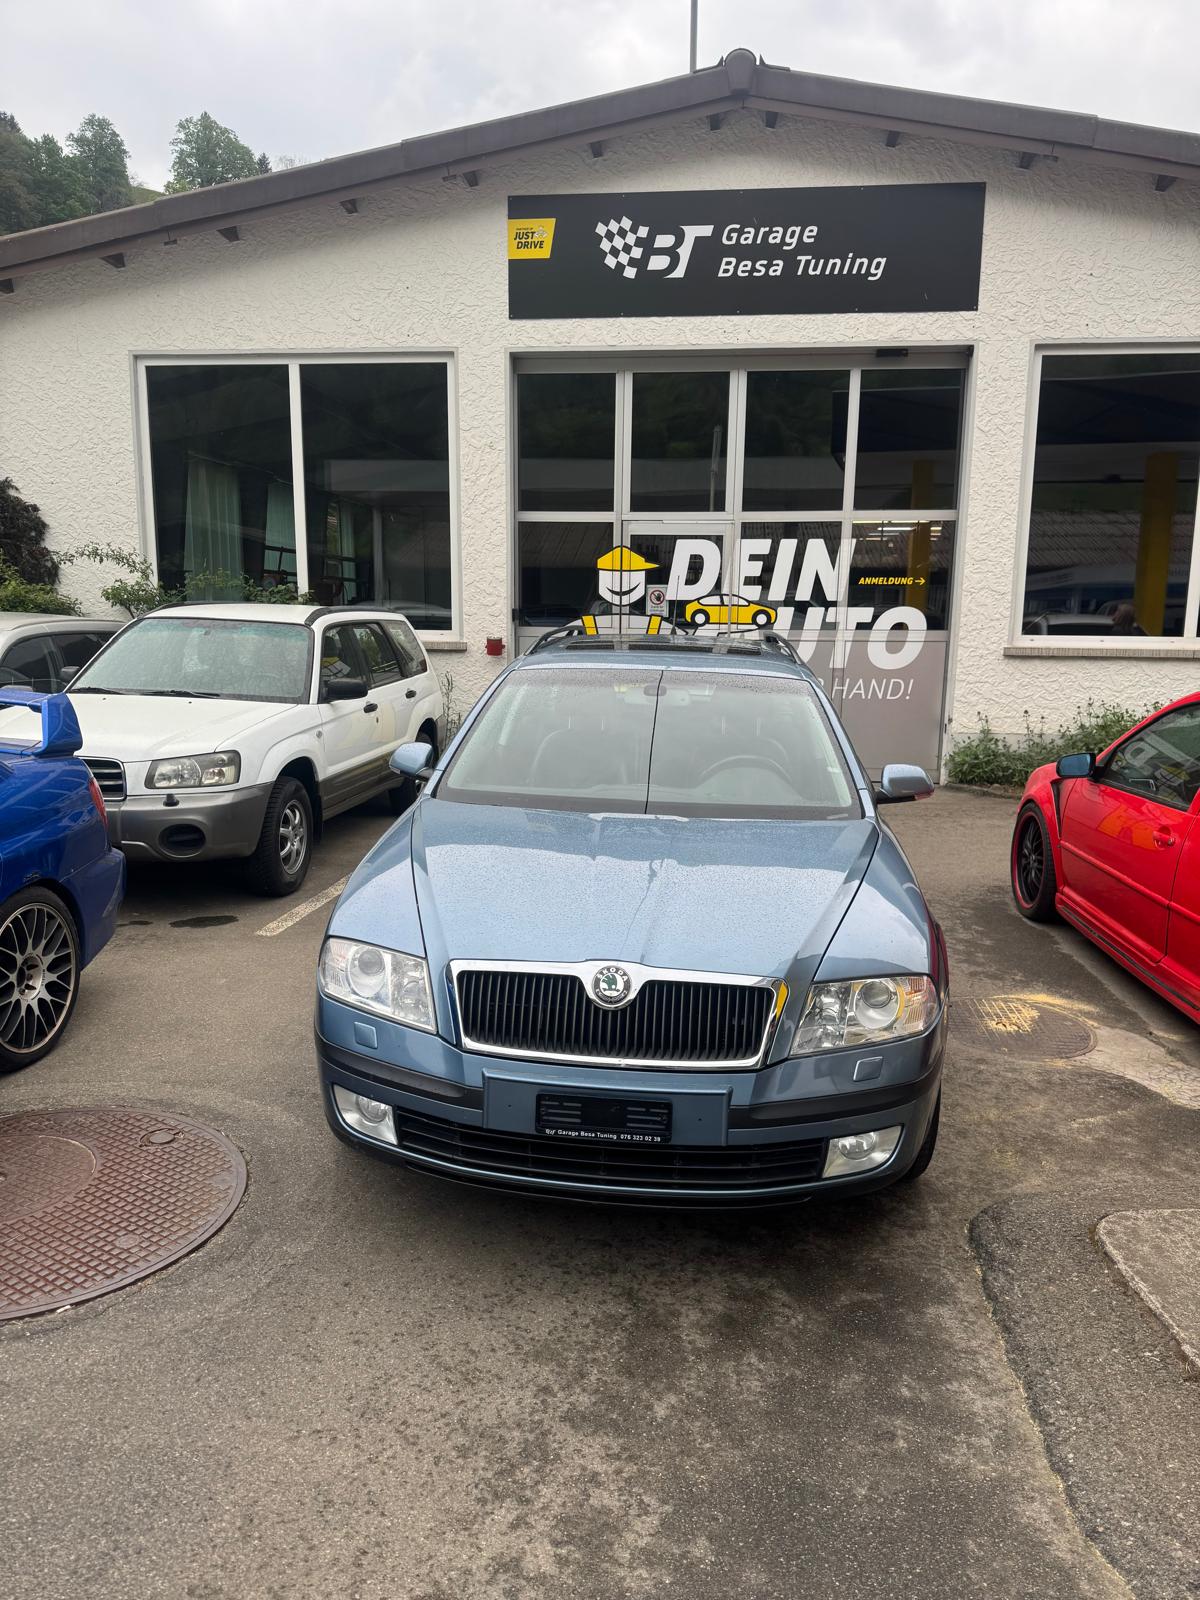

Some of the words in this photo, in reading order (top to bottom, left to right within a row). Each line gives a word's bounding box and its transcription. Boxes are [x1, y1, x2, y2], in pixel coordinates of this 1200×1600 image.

[514, 231, 536, 240] JUST
[516, 240, 545, 250] DRIVE
[721, 224, 818, 250] Garage
[717, 257, 784, 277] Besa
[796, 253, 887, 281] Tuning
[666, 538, 856, 601] DEIN
[858, 577, 914, 585] ANMELDUNG
[771, 606, 928, 670] UTO
[831, 678, 914, 700] HAND!
[557, 1129, 579, 1137] Garage
[597, 1132, 617, 1140] Tuning
